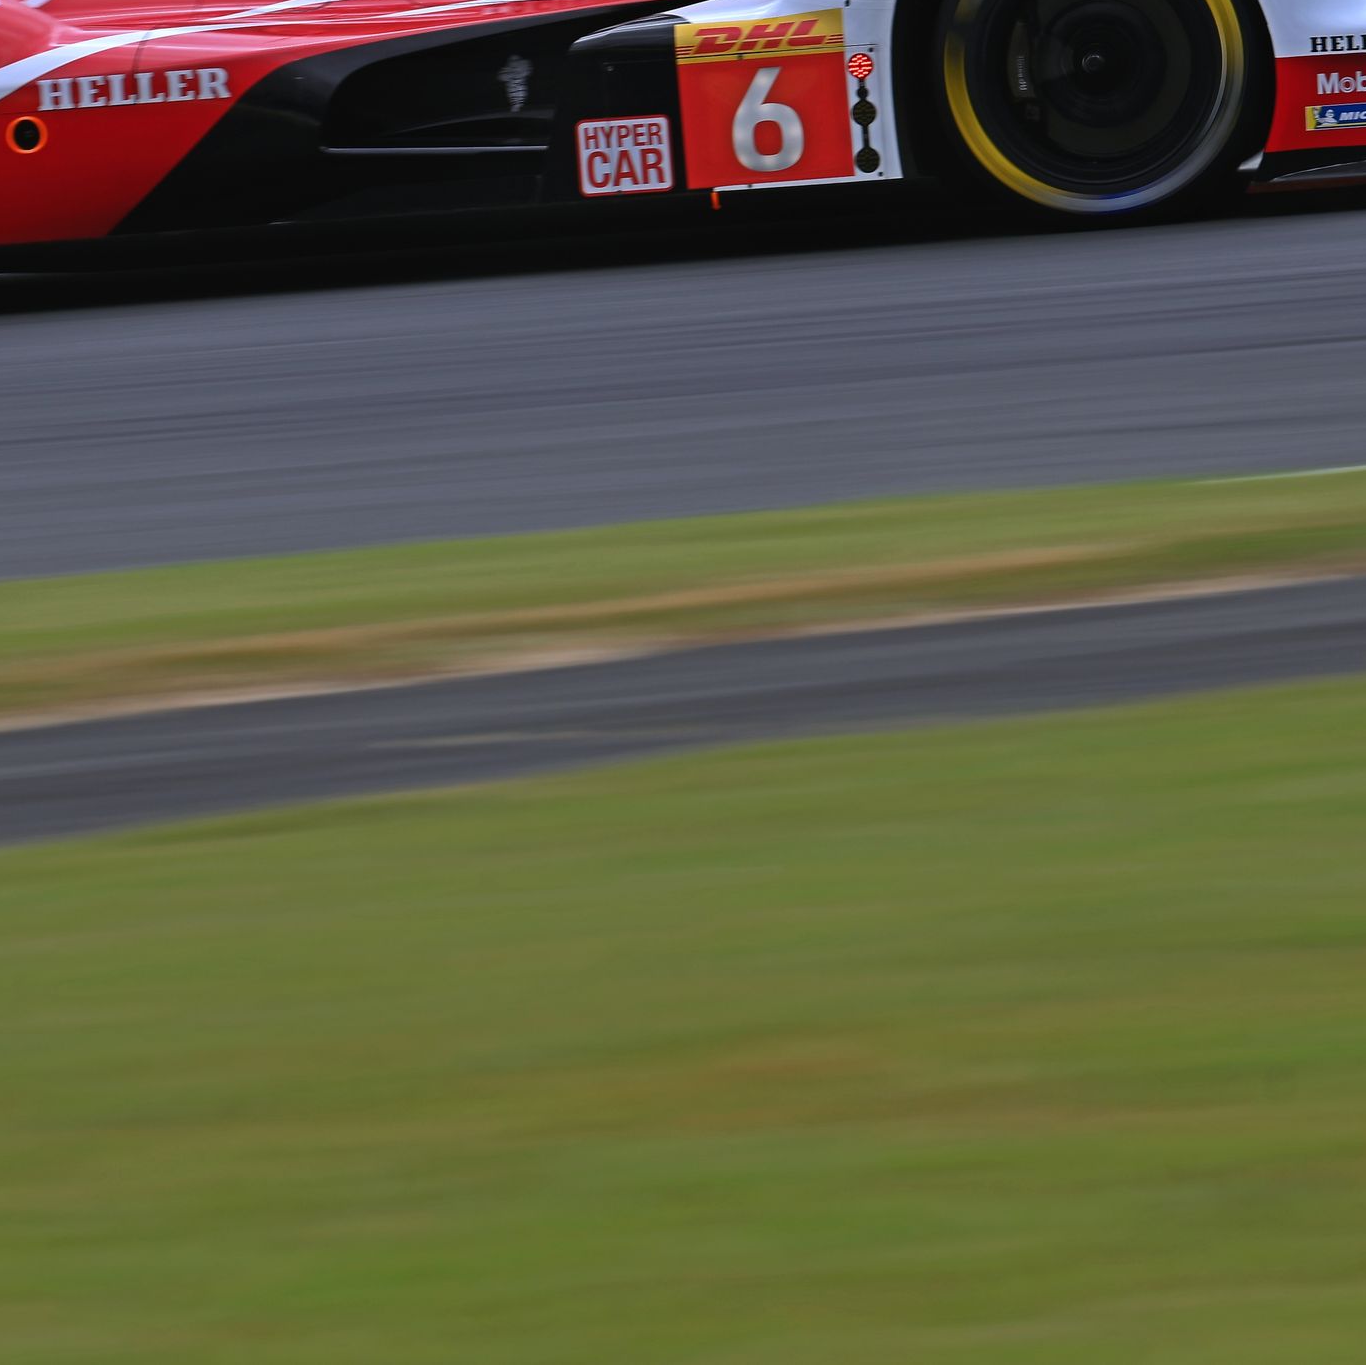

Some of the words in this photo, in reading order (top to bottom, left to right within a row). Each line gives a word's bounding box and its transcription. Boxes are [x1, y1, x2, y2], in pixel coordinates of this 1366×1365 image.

[689, 19, 827, 55] DHL
[37, 68, 232, 111] HELLER
[584, 122, 663, 150] HYPER
[732, 66, 804, 172] 6
[587, 148, 665, 188] CAR
